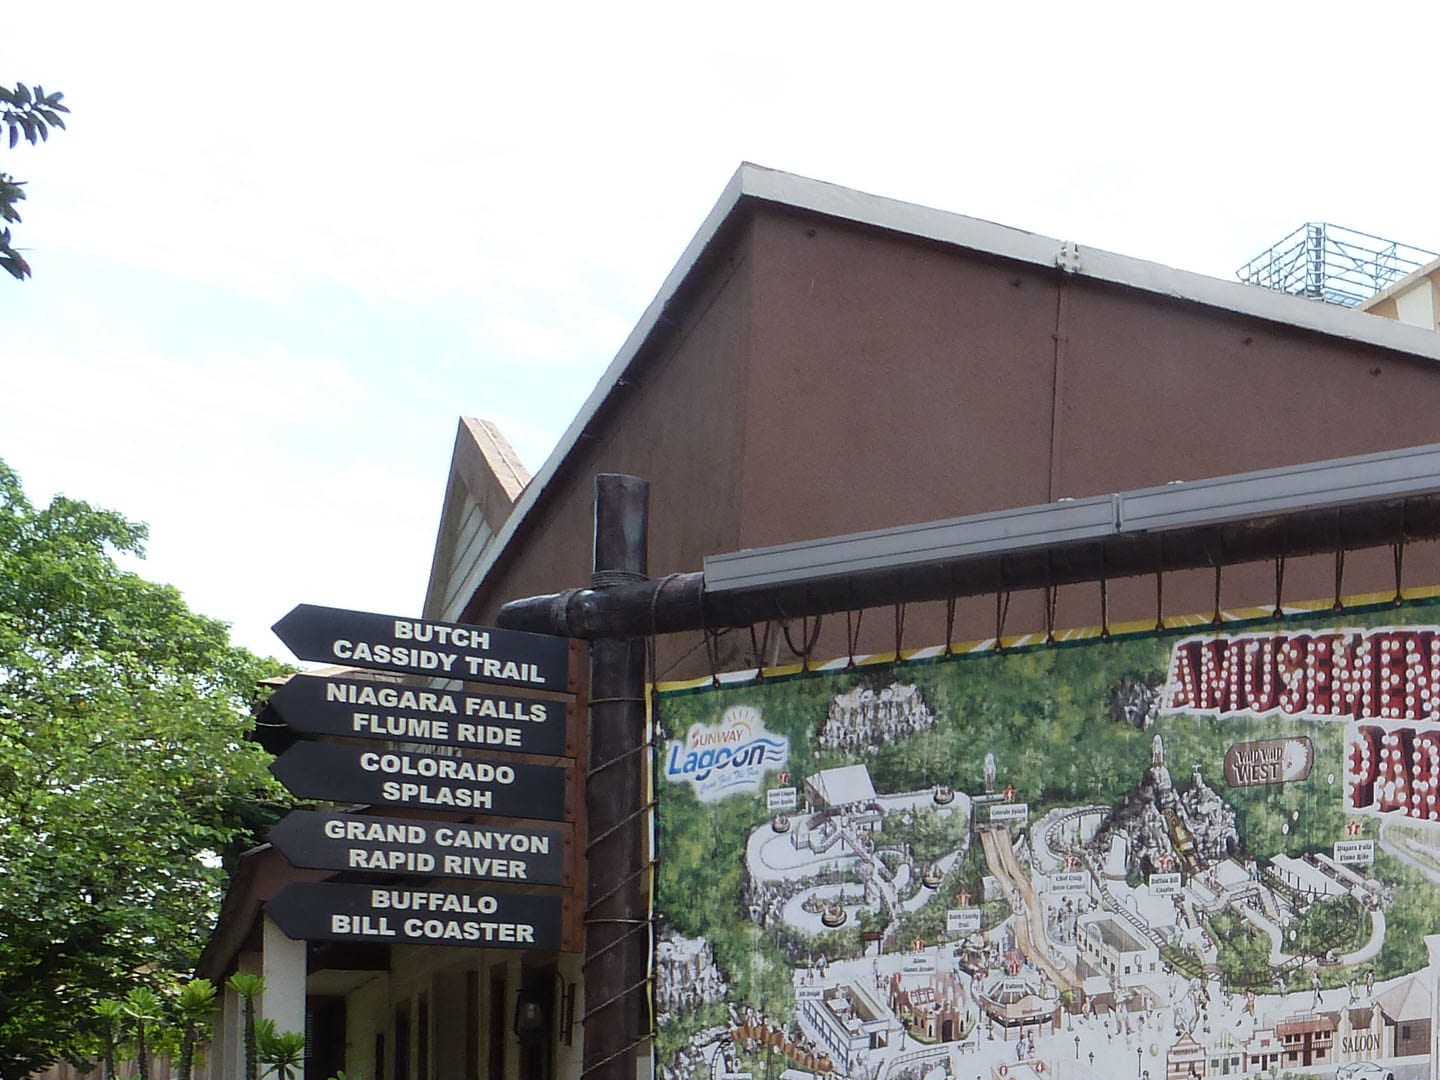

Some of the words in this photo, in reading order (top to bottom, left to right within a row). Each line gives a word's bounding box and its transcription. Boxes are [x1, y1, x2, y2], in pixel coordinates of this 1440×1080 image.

[394, 620, 490, 650] BUTCH
[332, 640, 458, 671] CASSIDY
[465, 656, 546, 684] TRAIL
[326, 683, 457, 714] NIAGARA
[465, 698, 547, 723] FALLS
[353, 713, 449, 740] FLUME
[457, 723, 522, 747] RIDE
[692, 728, 743, 749] SUNWAY
[360, 752, 516, 785] COLORADO
[668, 743, 765, 781] Lagoon
[1232, 762, 1279, 784] WEST
[382, 781, 493, 810] SPLASH
[324, 820, 426, 845] GRAND
[434, 828, 550, 855] CANYON
[349, 849, 435, 873] RAPID
[444, 856, 527, 880] RIVER
[371, 890, 498, 915] BUFFALO
[331, 915, 396, 936] BILL
[404, 919, 536, 944] COASTER
[1342, 1033, 1381, 1053] SALOON
